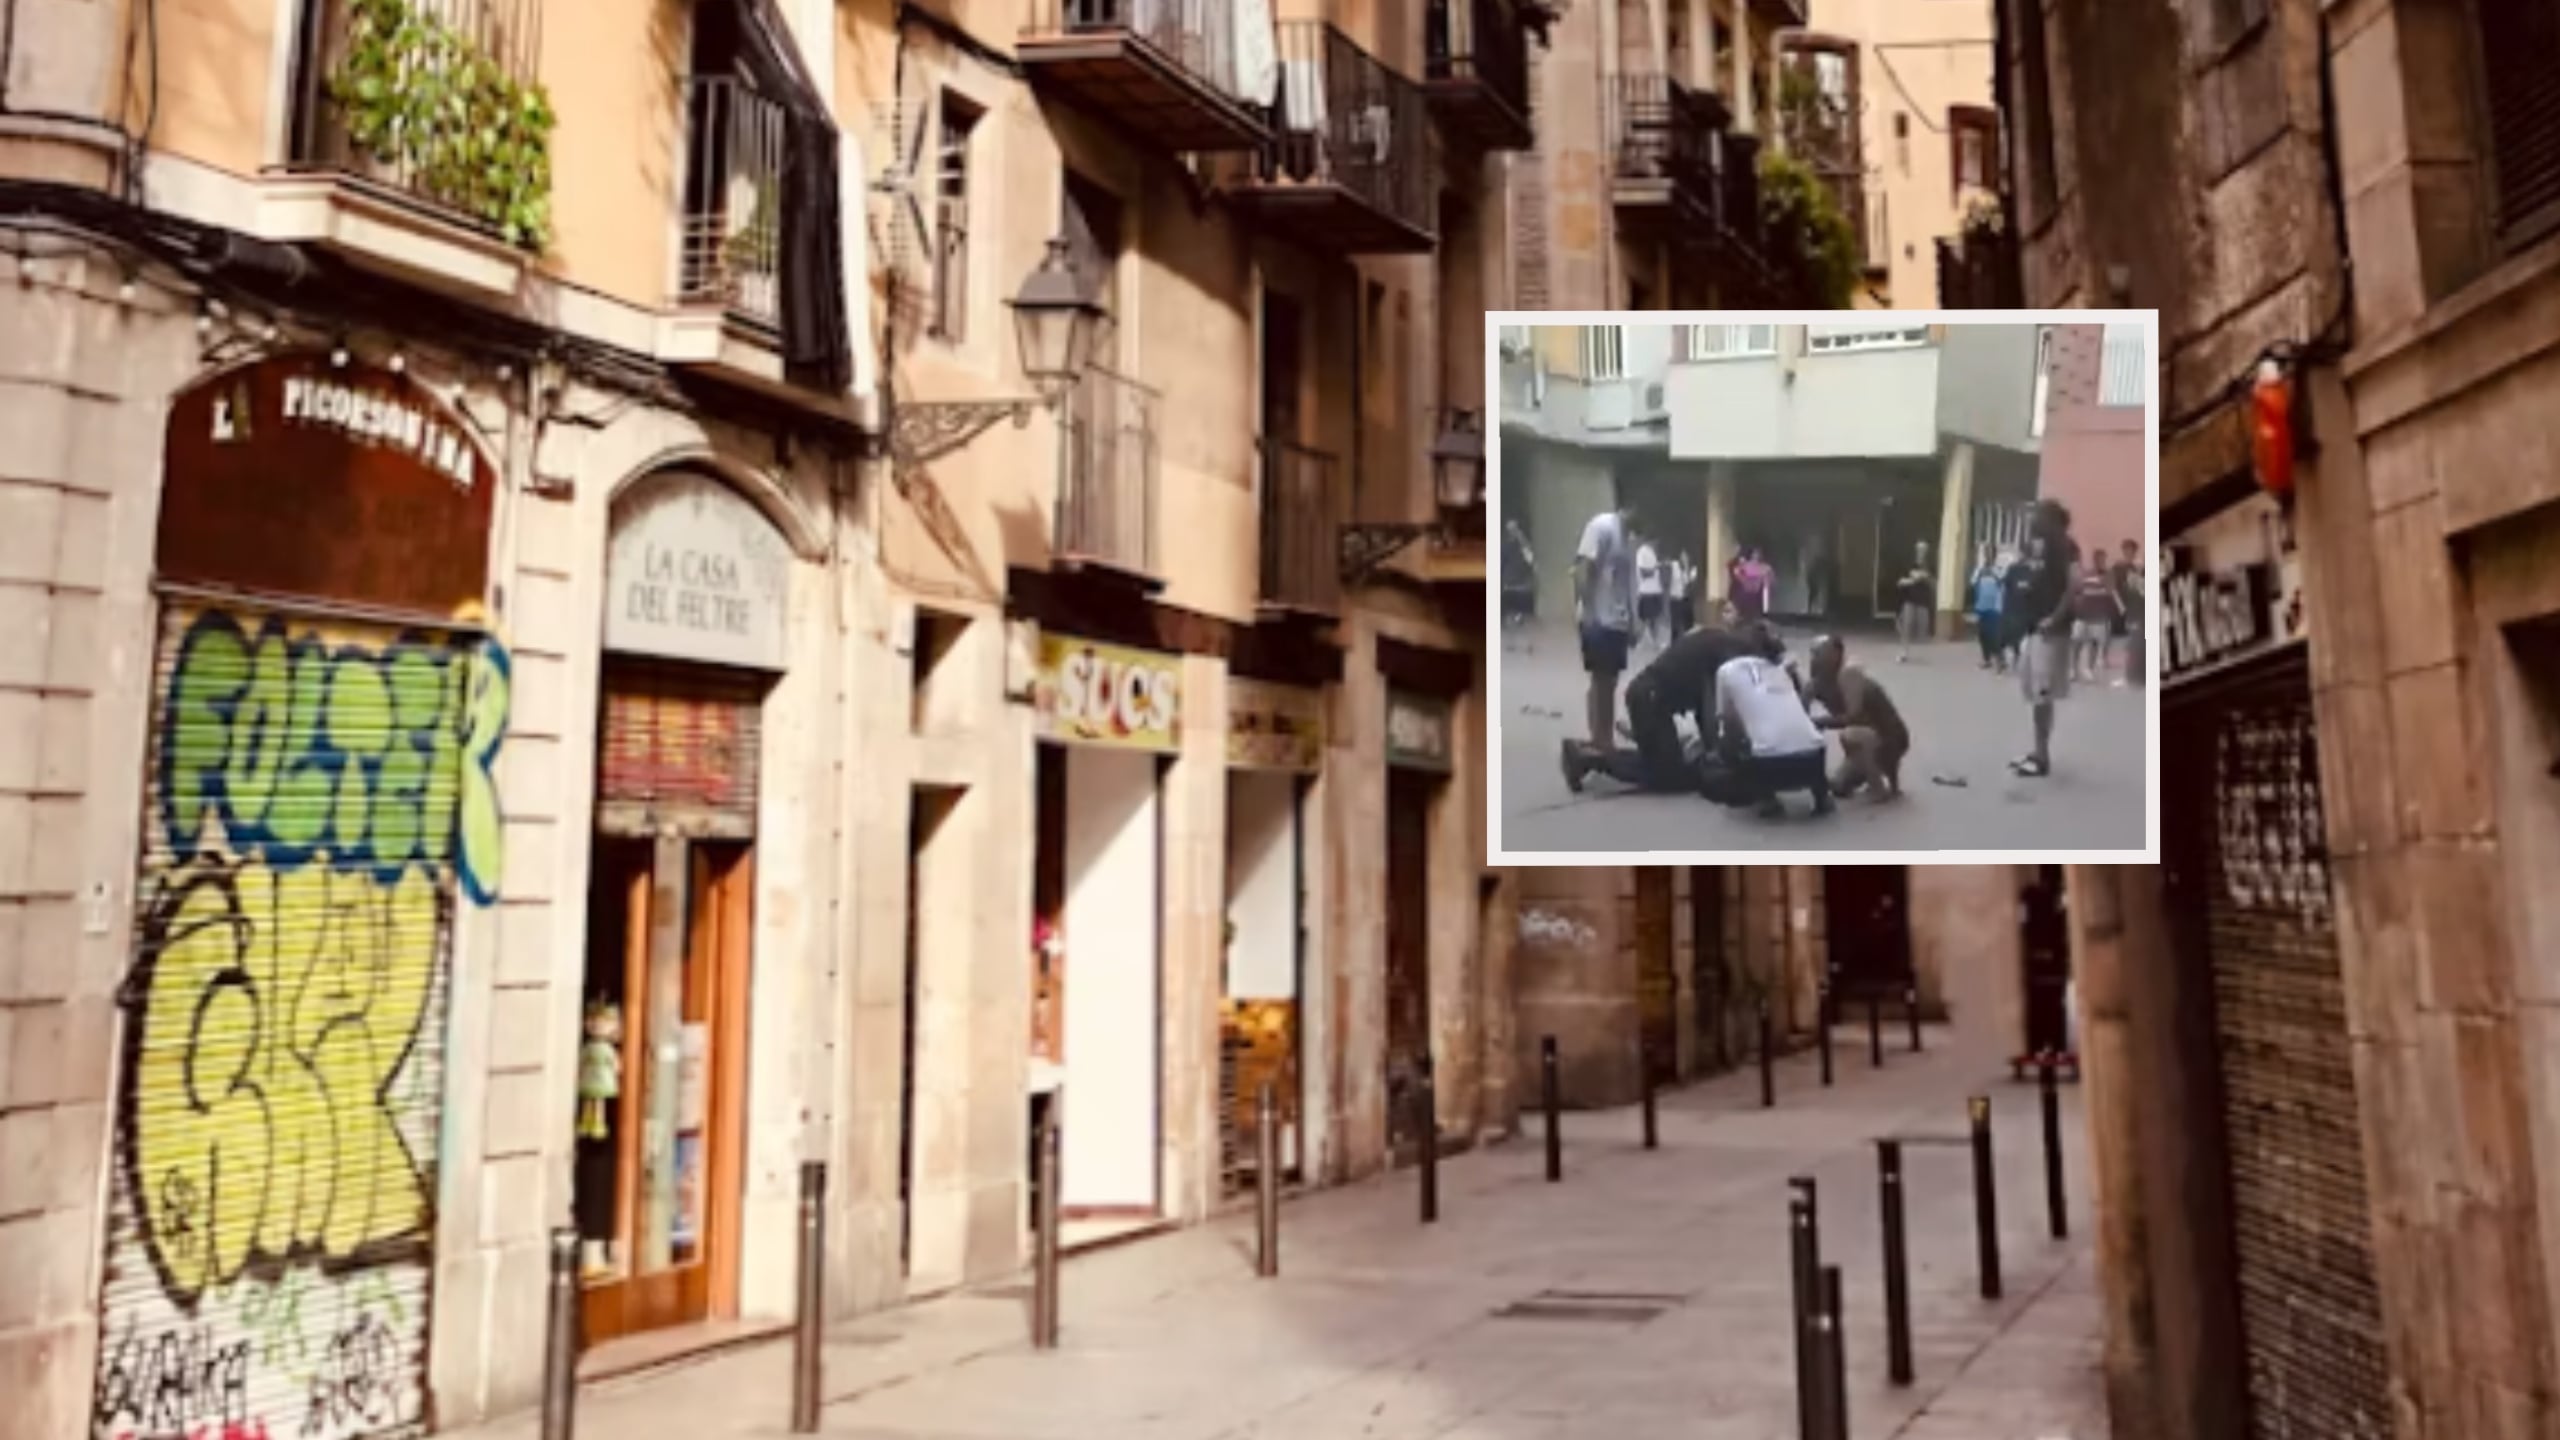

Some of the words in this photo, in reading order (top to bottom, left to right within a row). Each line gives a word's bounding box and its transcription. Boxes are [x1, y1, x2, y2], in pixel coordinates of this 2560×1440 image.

[644, 543, 673, 583] LA
[681, 549, 740, 592] CASA
[626, 581, 670, 626] DEL
[677, 589, 750, 635] FELTRE
[1057, 651, 1176, 730] SUCS
